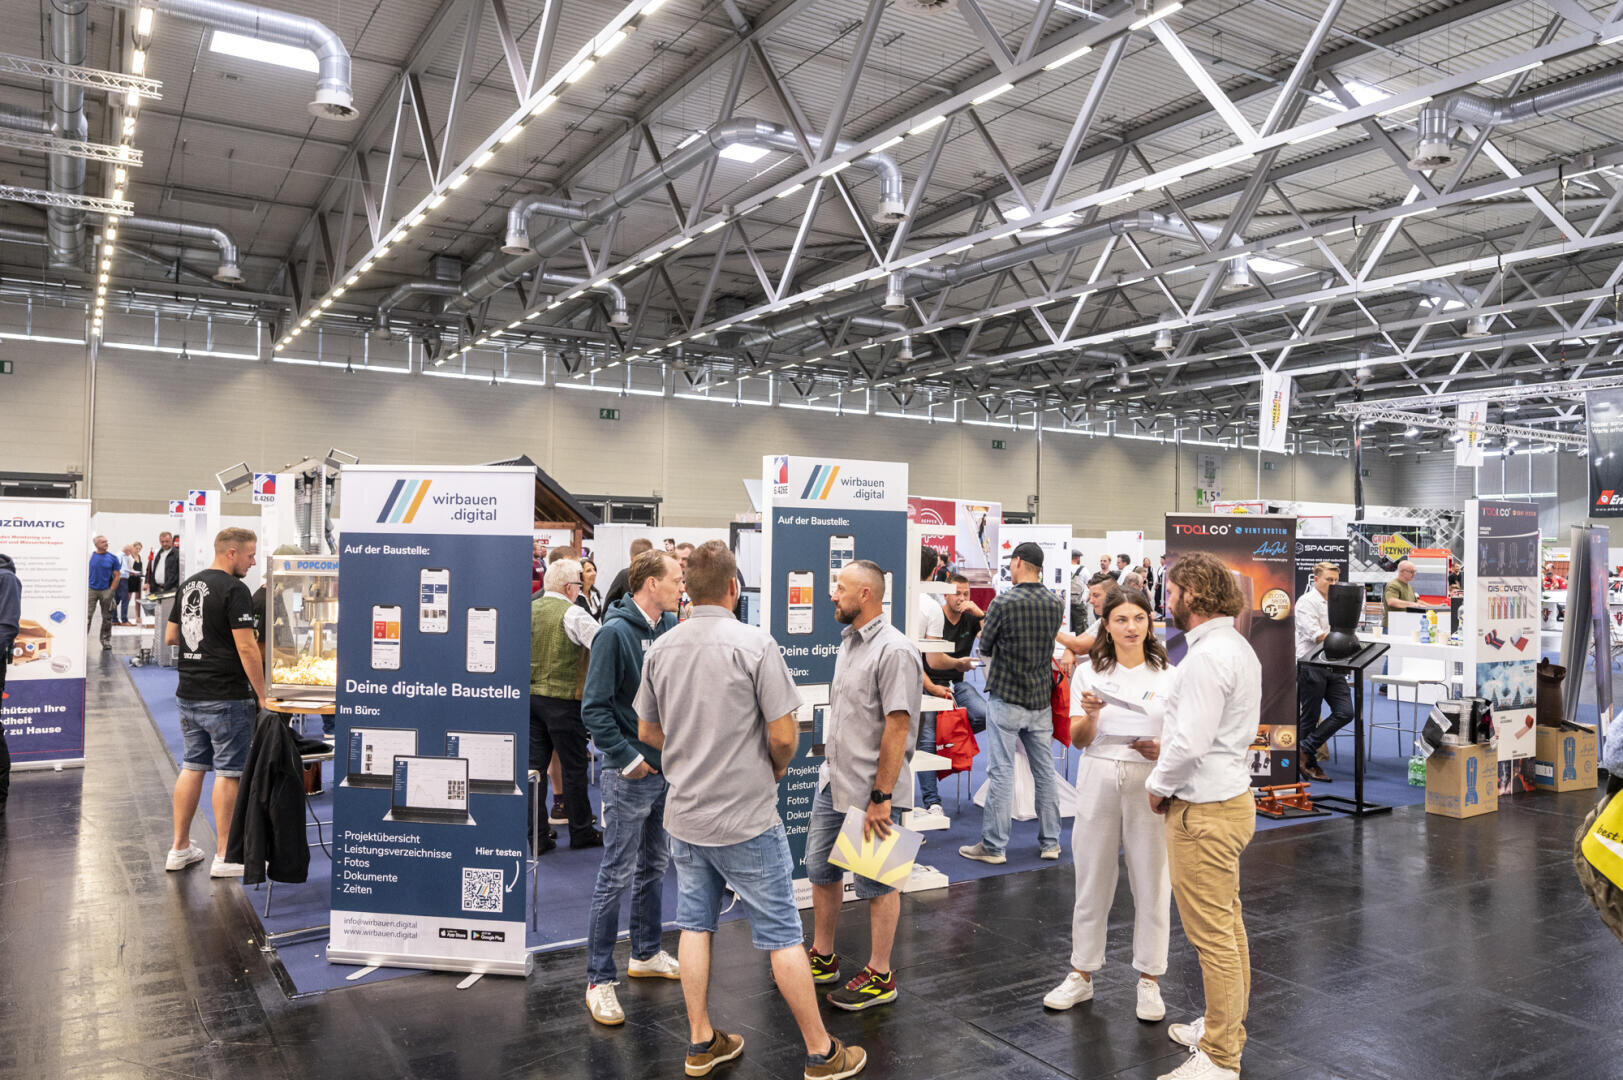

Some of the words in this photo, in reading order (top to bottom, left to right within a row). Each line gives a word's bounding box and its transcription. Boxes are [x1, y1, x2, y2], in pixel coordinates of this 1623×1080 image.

[841, 477, 885, 488] wirbauen
[433, 493, 497, 505] wirbauen
[853, 489, 885, 501] .digital
[450, 509, 497, 523] .digital
[777, 516, 794, 525] Auf
[795, 516, 809, 525] der
[811, 517, 850, 526] Baustelle:
[1172, 524, 1231, 535] TOOLCO
[1371, 534, 1396, 544] GRUPA
[344, 544, 363, 554] Auf
[364, 545, 381, 554] der
[383, 546, 430, 555] Baustelle:
[297, 561, 339, 569] POPCORN
[779, 645, 809, 656] Deine
[345, 679, 388, 694] Deine
[391, 681, 447, 698] digitale
[451, 683, 521, 699] Baustelle
[44, 705, 66, 713] Ihre
[340, 705, 352, 715] Im
[354, 705, 380, 716] Büro:
[786, 796, 809, 806] Fotos
[344, 831, 421, 844] Projektübersicht
[344, 844, 452, 859] Leistungsverzeichnisse
[475, 847, 494, 856] Hier
[495, 848, 522, 857] testen
[344, 857, 370, 868] Fotos
[343, 870, 398, 883] Dokumente
[343, 884, 373, 895] Zeiten
[343, 917, 418, 929] info@wirbauen.digital
[343, 928, 418, 939] www.wirbauen.digital
